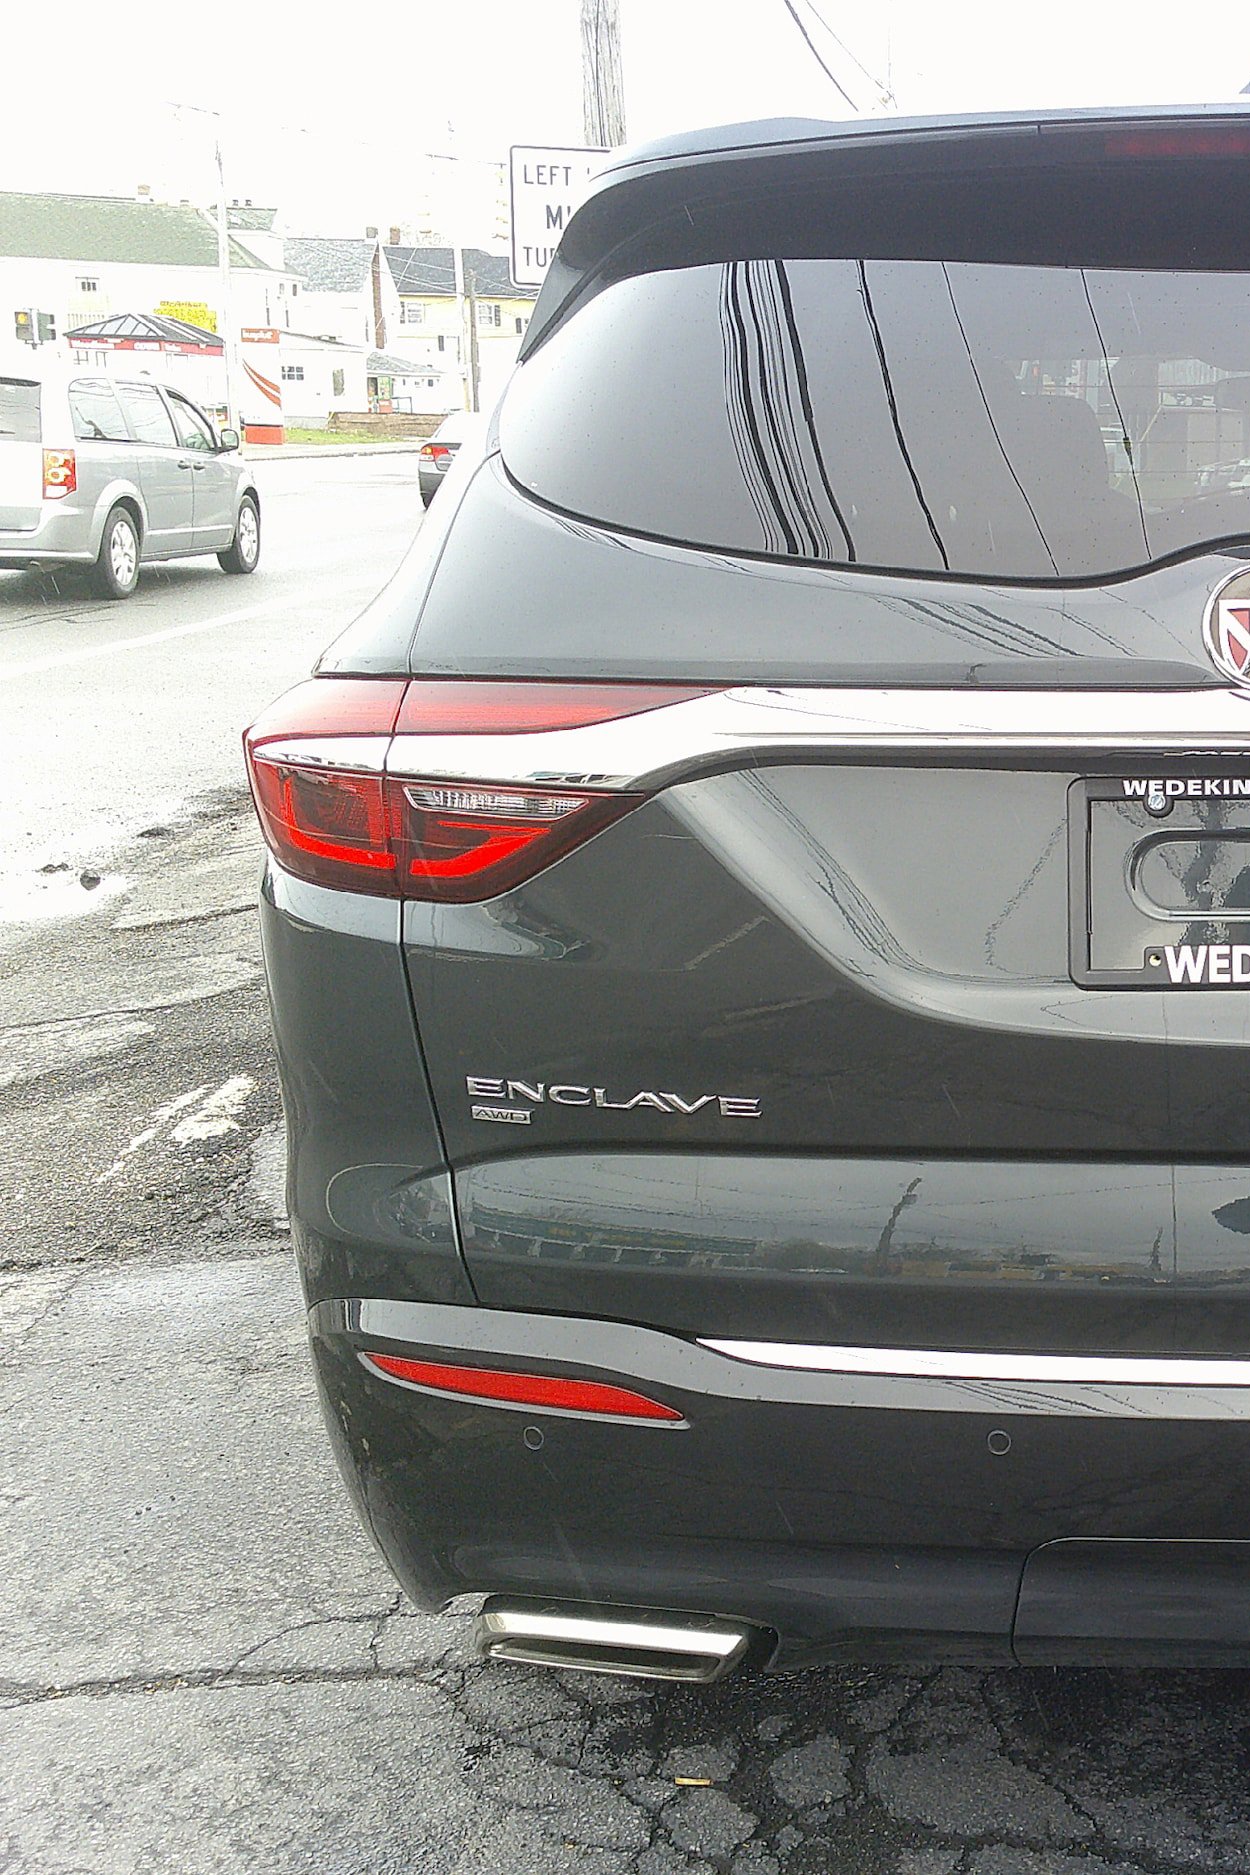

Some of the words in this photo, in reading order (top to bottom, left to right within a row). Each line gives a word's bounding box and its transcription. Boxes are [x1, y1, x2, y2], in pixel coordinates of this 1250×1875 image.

[523, 164, 572, 186] LEFT
[466, 1075, 763, 1118] ENCLAVE
[475, 1108, 527, 1121] AWD
